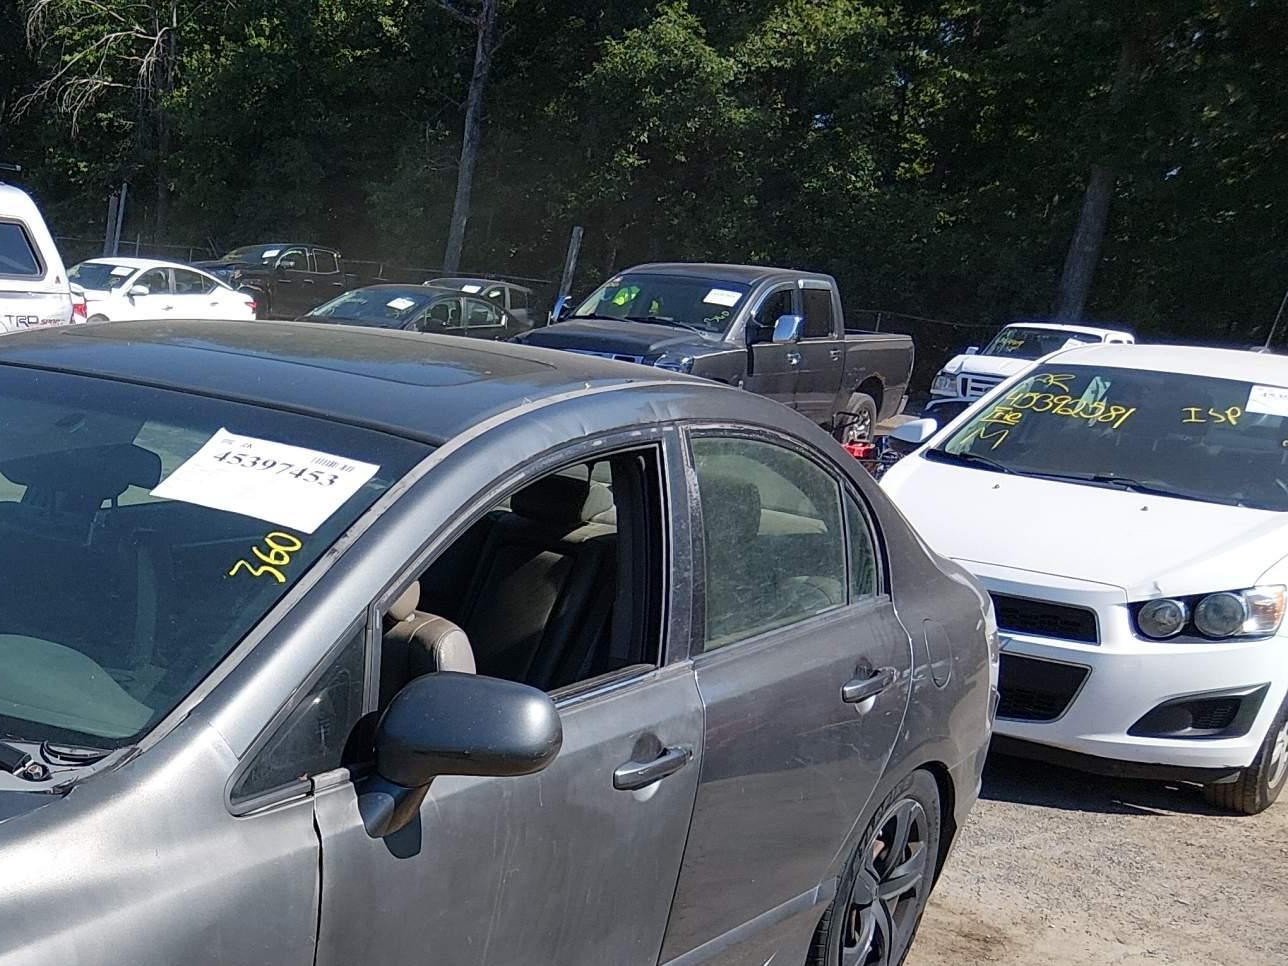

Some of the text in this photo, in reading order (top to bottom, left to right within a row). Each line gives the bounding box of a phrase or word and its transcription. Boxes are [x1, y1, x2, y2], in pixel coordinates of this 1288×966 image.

[4, 314, 39, 328] TRD
[212, 450, 340, 488] 45397453
[228, 531, 303, 583] 360
